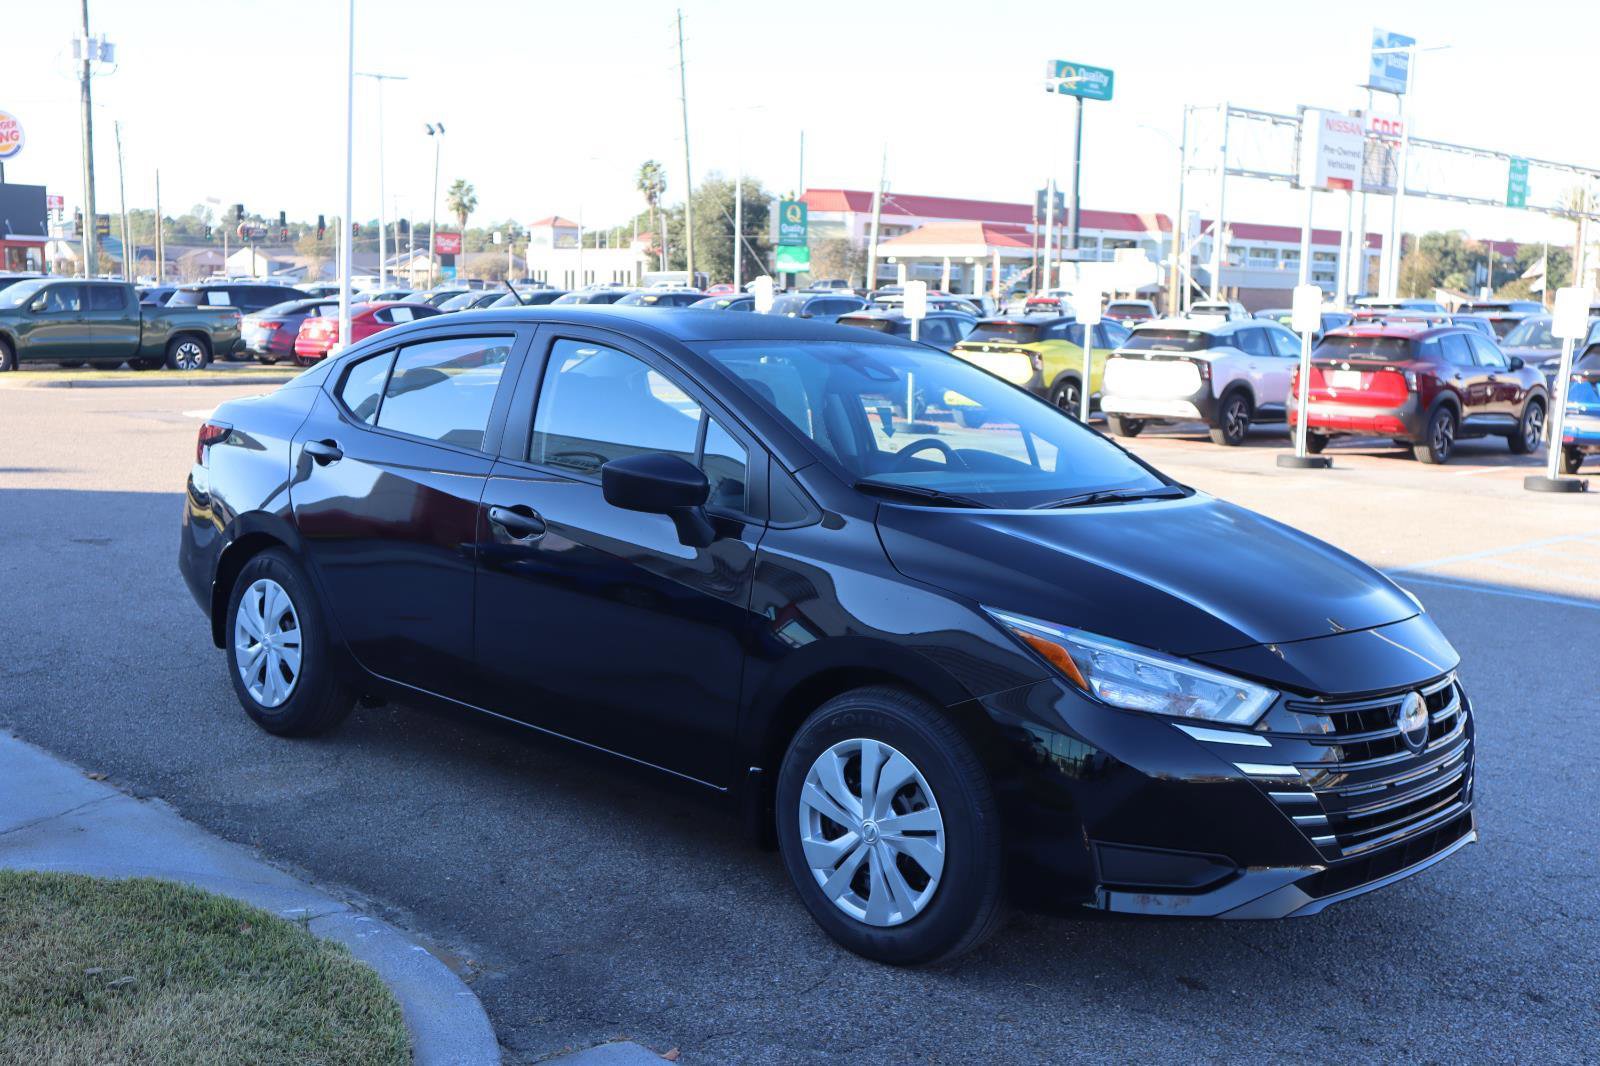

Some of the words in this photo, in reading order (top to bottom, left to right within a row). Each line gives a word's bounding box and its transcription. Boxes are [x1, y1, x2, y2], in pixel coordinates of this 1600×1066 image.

[1078, 68, 1109, 87] Quality
[1325, 118, 1362, 136] NISSAN
[1324, 144, 1361, 159] Pre-Owned
[1327, 159, 1356, 171] Vehicles
[781, 223, 805, 235] Quality
